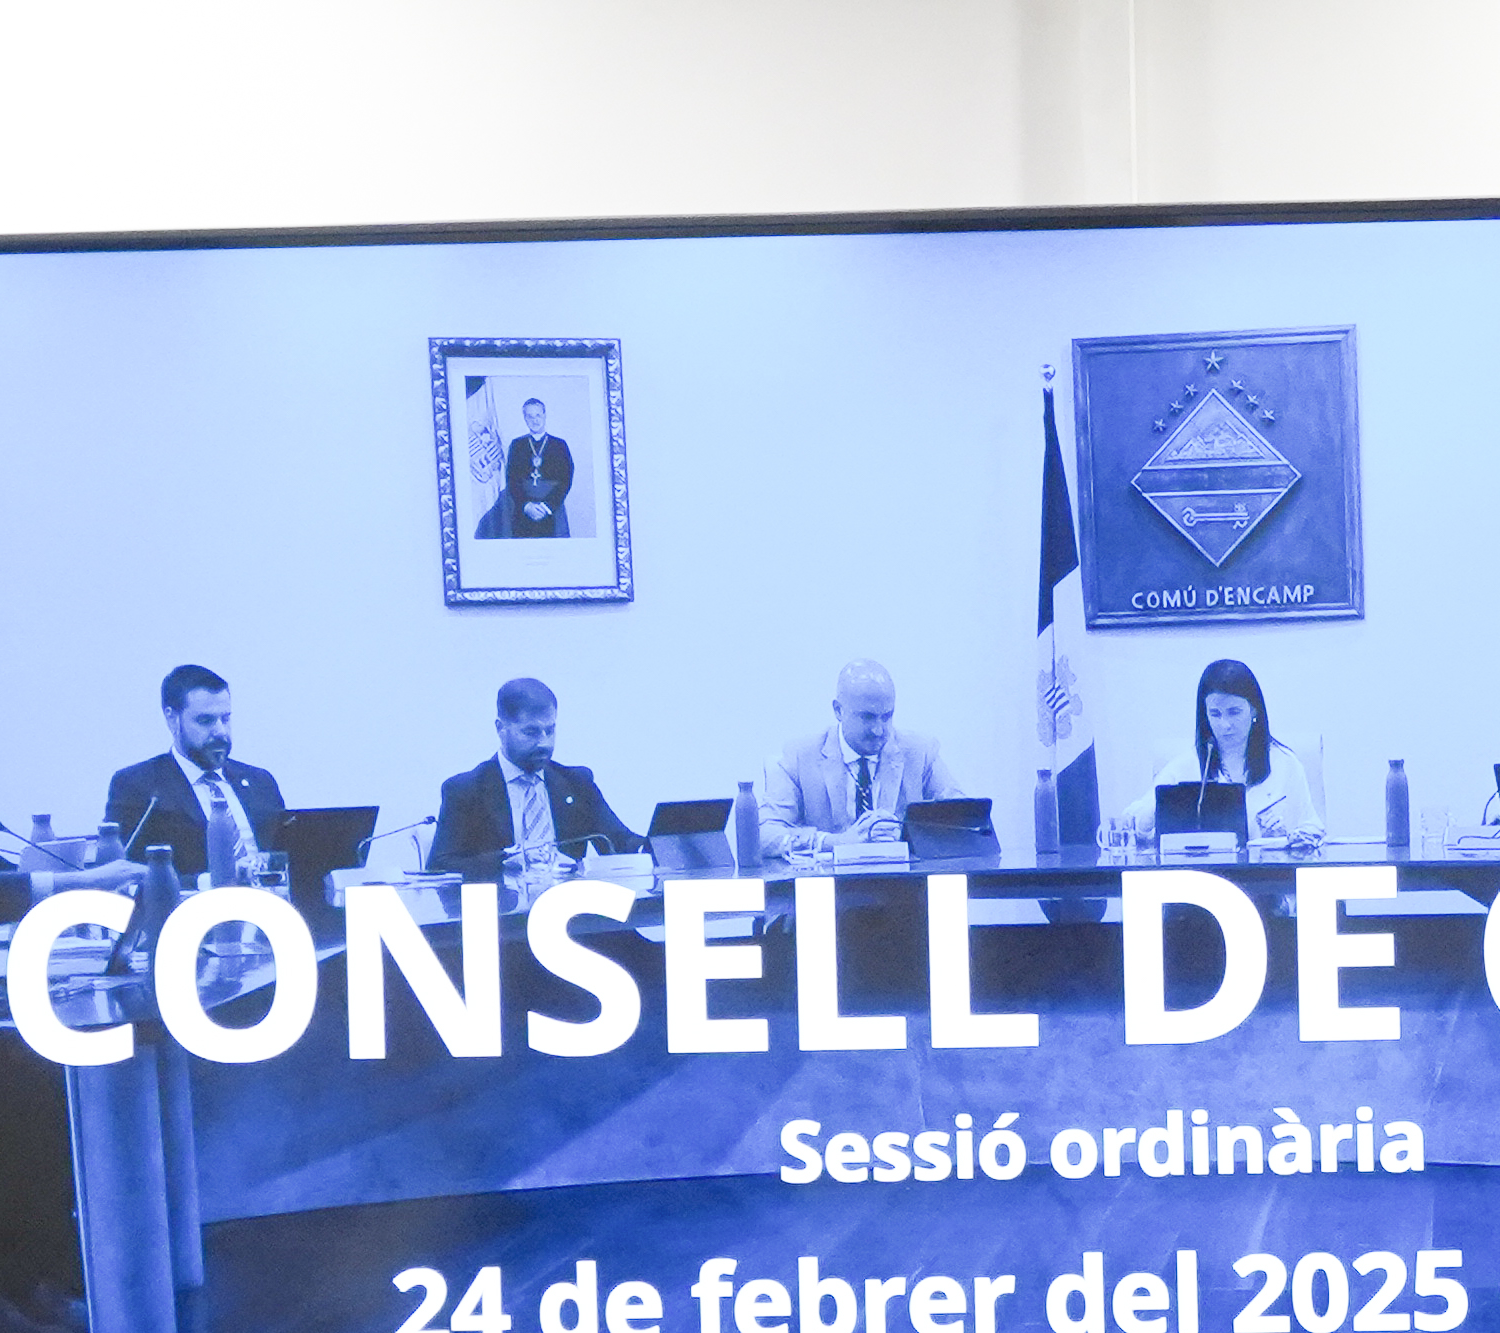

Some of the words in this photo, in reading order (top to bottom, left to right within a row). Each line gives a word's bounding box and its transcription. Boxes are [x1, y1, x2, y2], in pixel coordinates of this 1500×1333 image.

[1130, 584, 1198, 610] COMÚ
[1204, 583, 1315, 607] D'ENCAMP
[4, 873, 1041, 1068] CONSELL
[1120, 864, 1402, 1046] DE
[778, 1110, 1029, 1186] Sessió
[1049, 1104, 1427, 1181] ordinària
